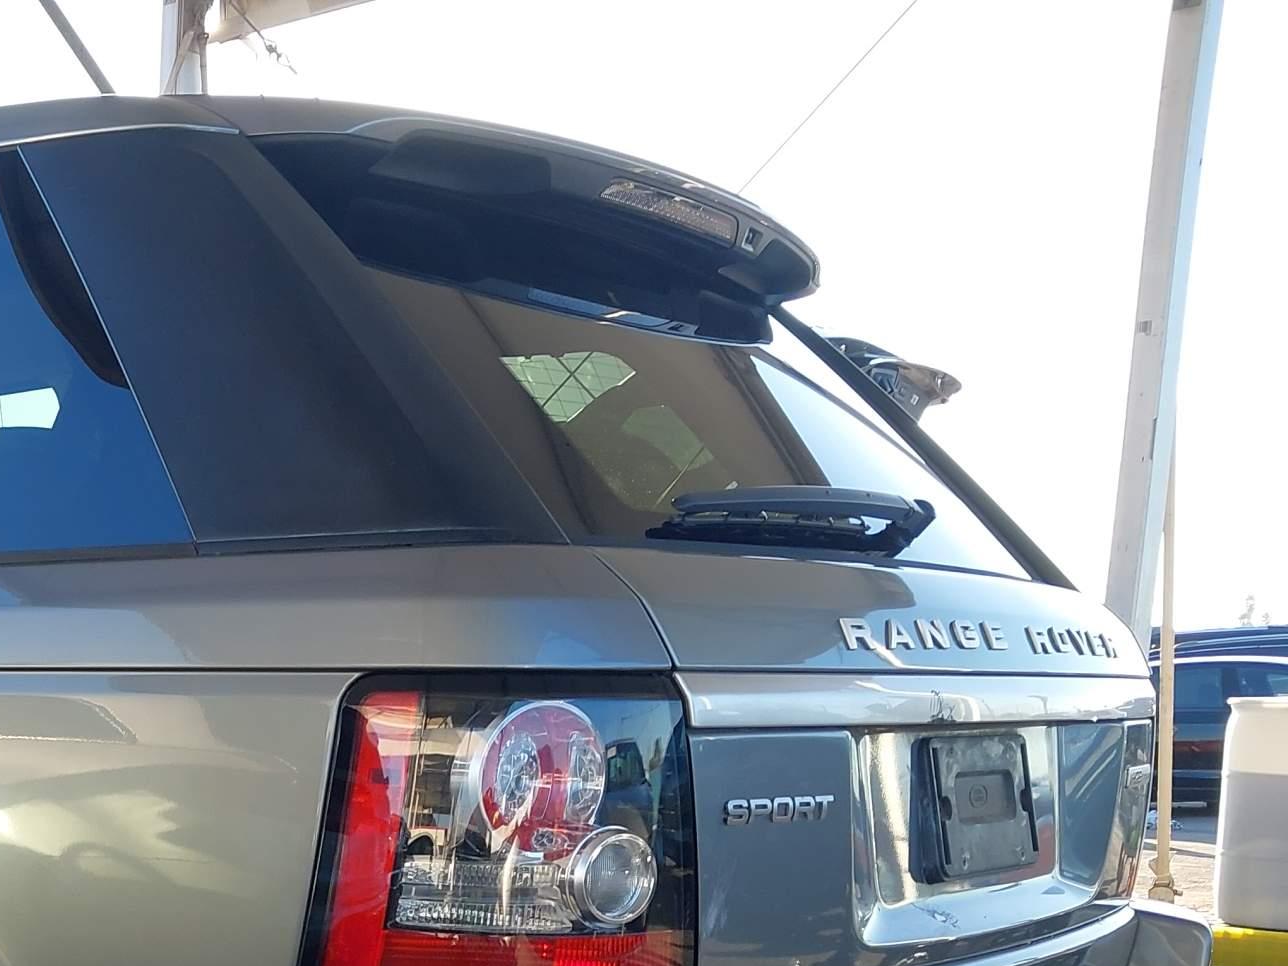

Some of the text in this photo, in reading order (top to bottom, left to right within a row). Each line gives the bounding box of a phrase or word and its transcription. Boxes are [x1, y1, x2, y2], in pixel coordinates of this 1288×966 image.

[839, 617, 1118, 659] RANGE ROVER
[723, 794, 834, 825] SPORT
